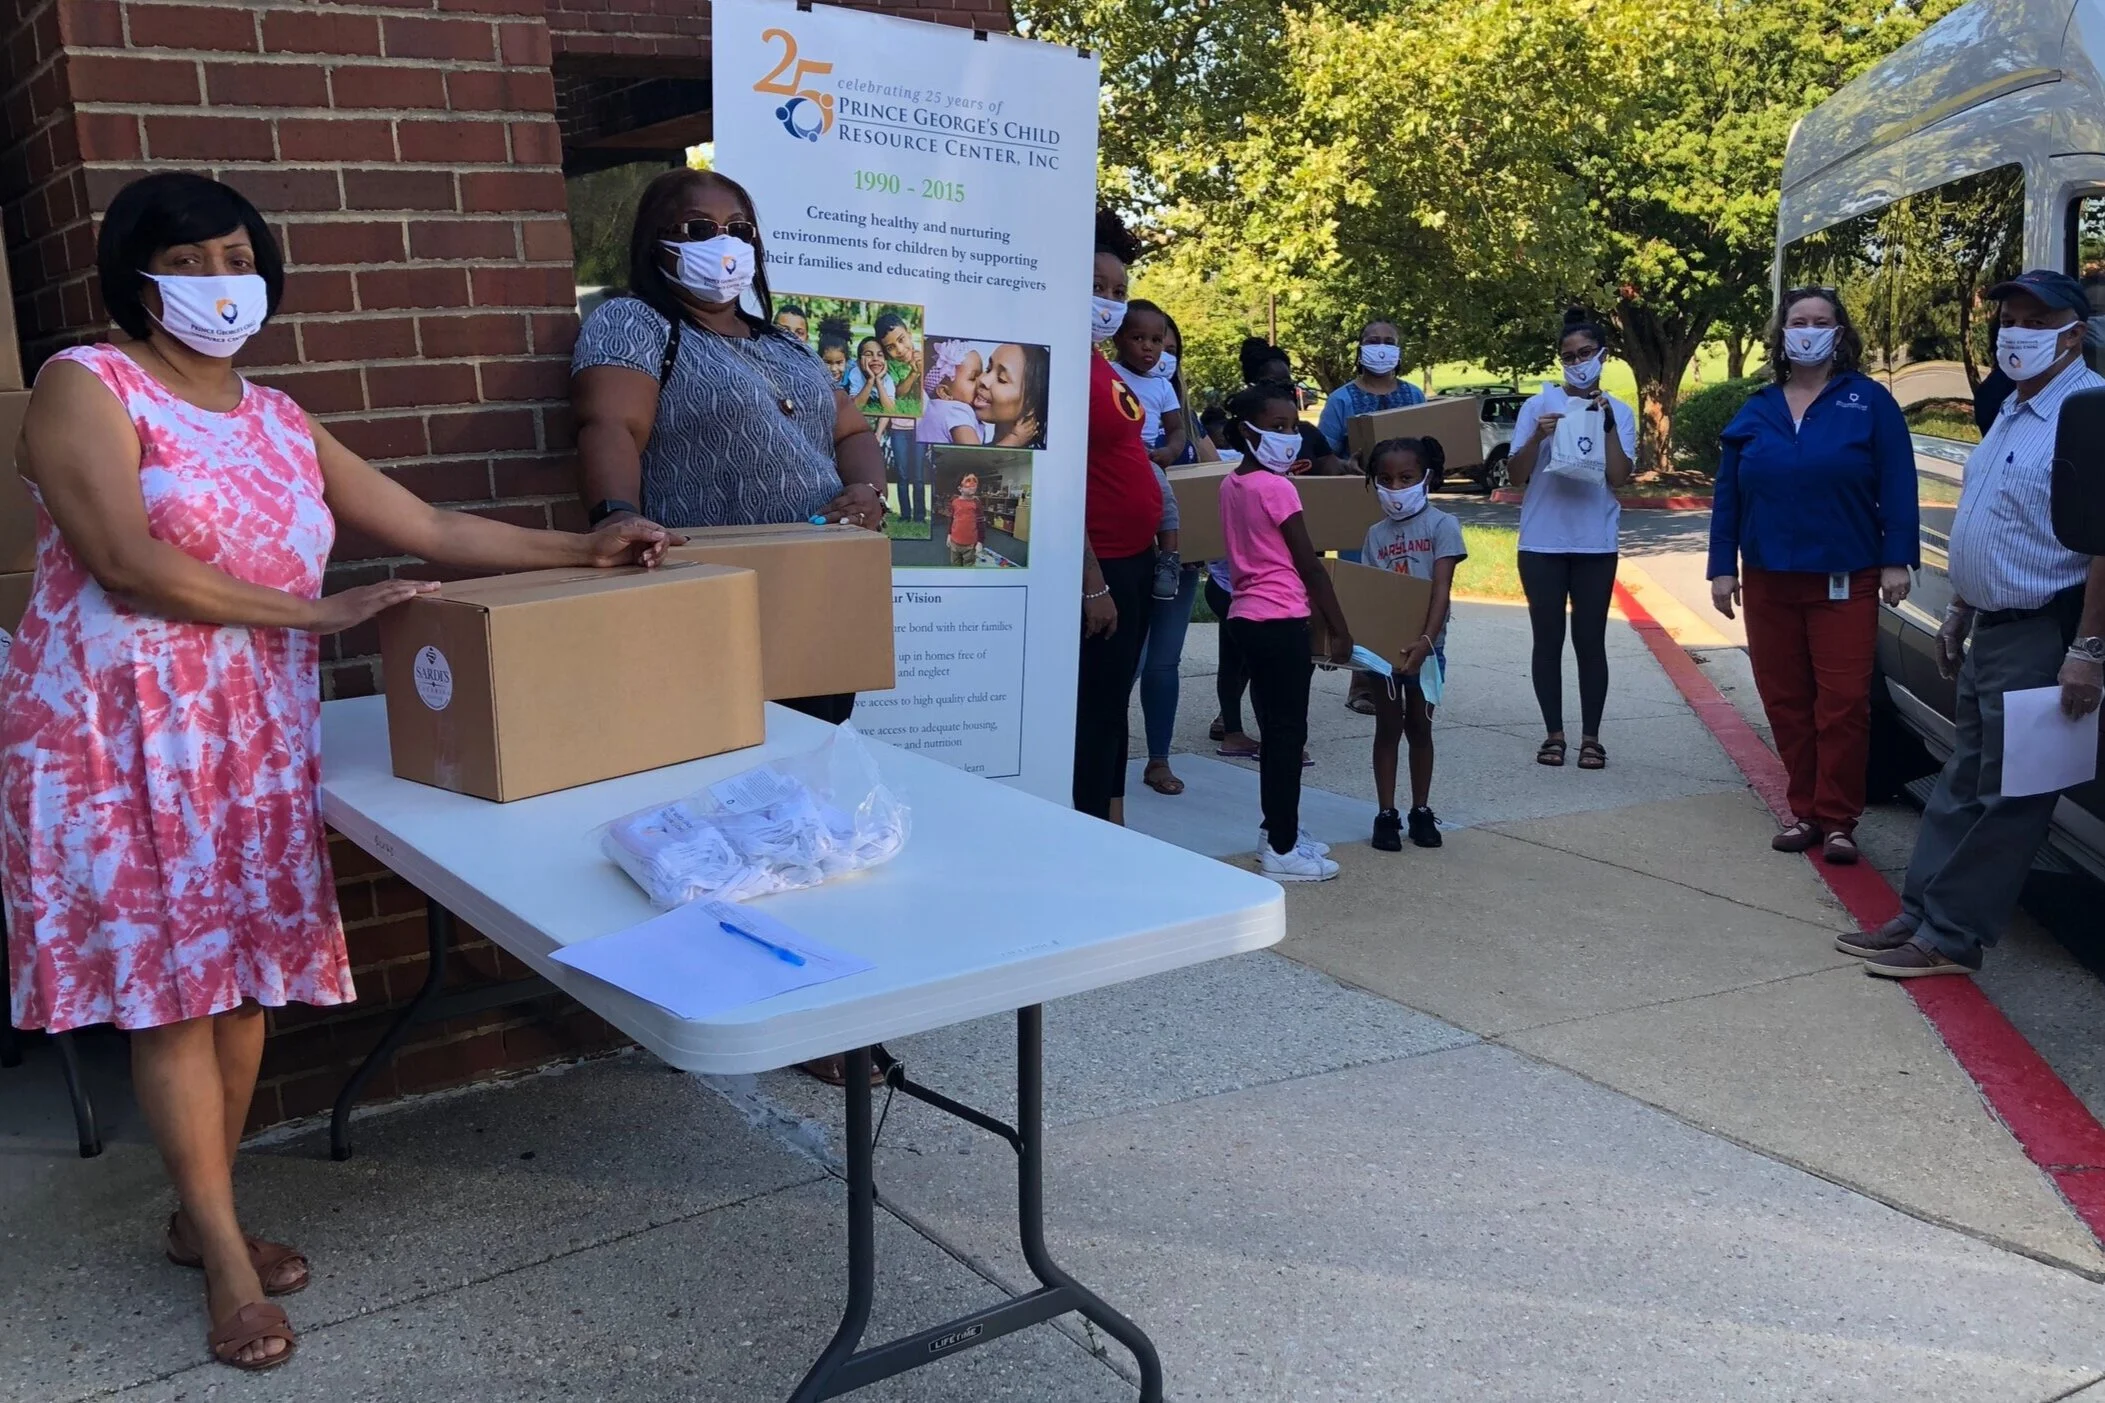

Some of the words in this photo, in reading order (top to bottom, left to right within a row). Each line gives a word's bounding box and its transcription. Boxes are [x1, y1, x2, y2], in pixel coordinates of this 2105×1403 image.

[838, 78, 921, 104] celebrating
[925, 88, 942, 104] 25
[944, 95, 983, 110] years
[988, 100, 1004, 116] of
[838, 96, 908, 123] PRINCE
[913, 108, 999, 137] GEORGE'S
[1003, 121, 1061, 145] CHILD
[838, 123, 938, 153] RESOURCE
[945, 139, 1021, 167] CENTER,
[1028, 150, 1060, 170] INC
[854, 169, 901, 195] 1990
[921, 178, 965, 203] 2015
[806, 205, 868, 228] Creating
[871, 212, 920, 234] healthy
[923, 221, 947, 234] and
[950, 225, 1011, 245] nurturing
[772, 229, 869, 249] environments
[872, 237, 892, 251] for
[895, 240, 948, 258] children
[951, 246, 967, 263] by
[969, 250, 1039, 271] supporting
[763, 249, 795, 265] heir
[798, 253, 854, 271] families
[857, 261, 883, 274] and
[886, 263, 951, 285] educating
[954, 269, 983, 284] their
[986, 276, 1047, 292] caregivers
[1377, 538, 1432, 560] MARYLAND
[892, 595, 903, 604] ur
[905, 592, 942, 604] Vision
[909, 621, 934, 633] bond
[936, 622, 956, 633] with
[958, 621, 979, 632] their
[981, 620, 1014, 632] families
[898, 653, 911, 664] up
[913, 650, 922, 661] in
[925, 650, 955, 661] homes
[957, 649, 974, 660] free
[976, 648, 988, 660] of
[898, 667, 915, 678] and
[918, 667, 950, 680] neglect
[868, 698, 899, 707] access
[901, 698, 911, 707] to
[913, 695, 934, 709] high
[935, 693, 966, 708] quality
[967, 692, 988, 703] child
[990, 693, 1007, 702] care
[859, 728, 875, 736] ave
[877, 727, 907, 736] access
[909, 725, 919, 734] to
[921, 722, 961, 735] adequate
[904, 738, 922, 750] and
[924, 737, 963, 749] nutrition
[964, 763, 985, 773] learn
